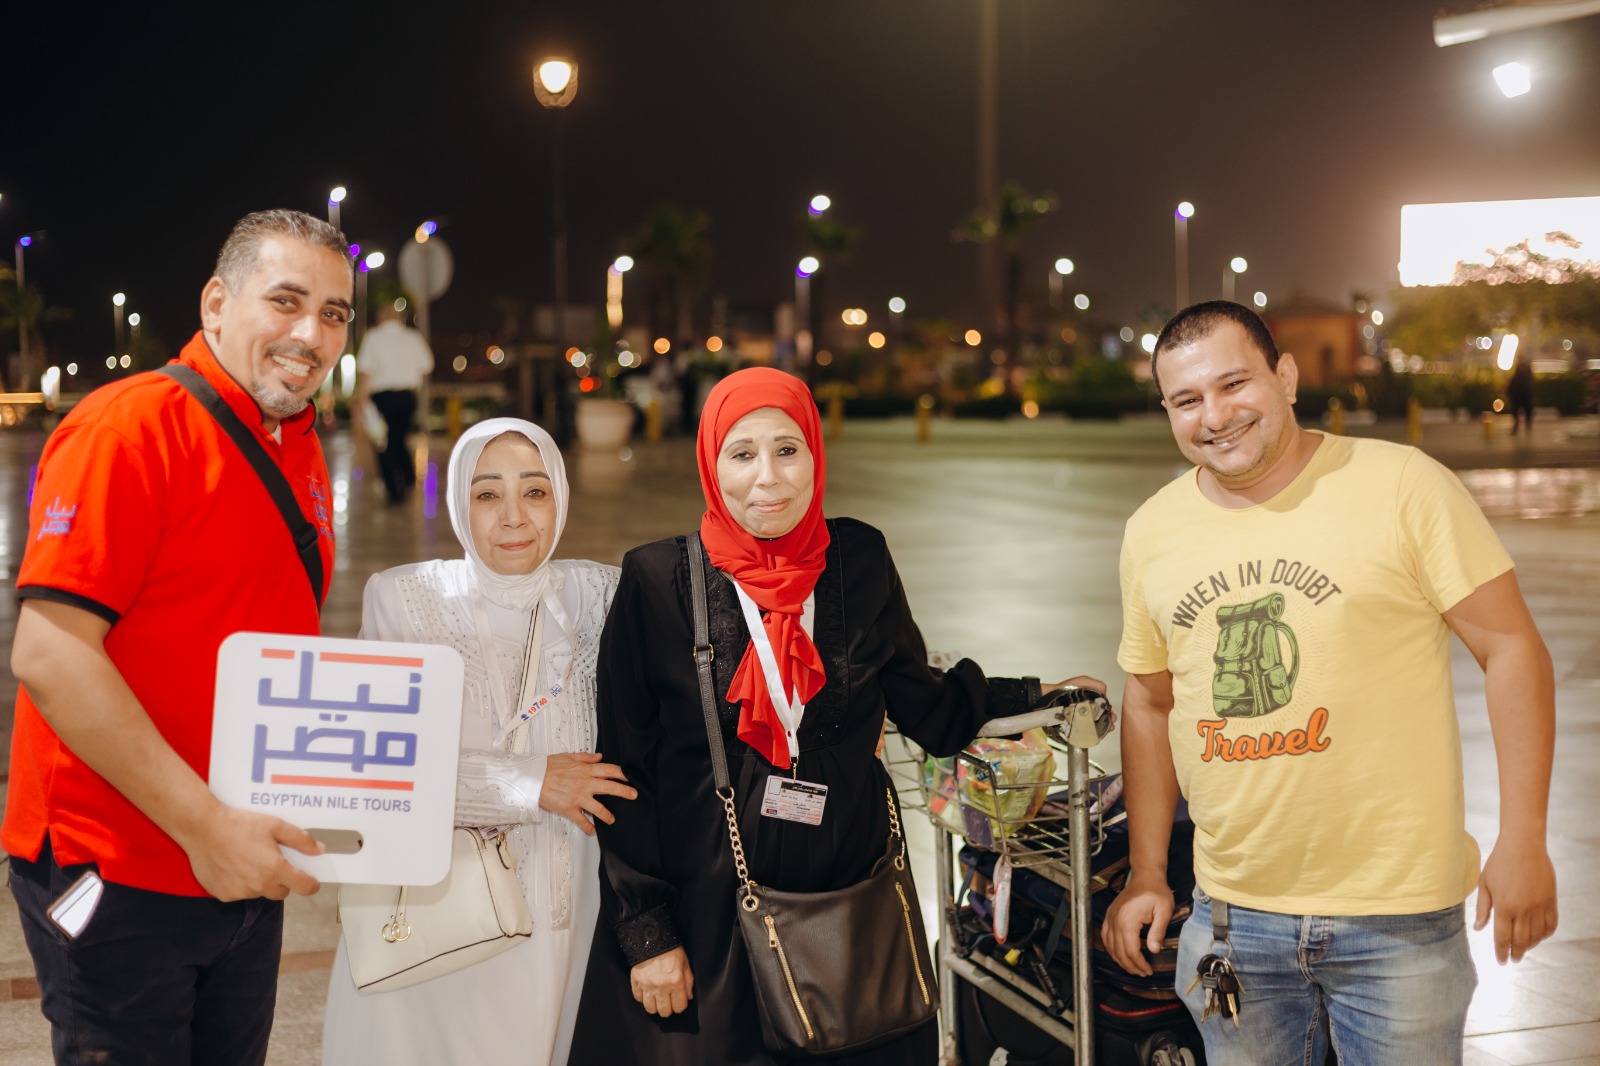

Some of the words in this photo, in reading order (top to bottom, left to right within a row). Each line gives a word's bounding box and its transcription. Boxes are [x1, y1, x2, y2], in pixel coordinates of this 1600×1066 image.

[1171, 570, 1230, 629] WHEN
[1238, 559, 1262, 588] IN
[1269, 558, 1343, 606] DOUBT
[257, 650, 423, 721] نيل
[250, 723, 418, 784] مصر
[1196, 706, 1332, 763] Travel
[250, 792, 323, 809] EGYPTIAN
[327, 796, 358, 810] NILE
[363, 798, 412, 813] TOURS
